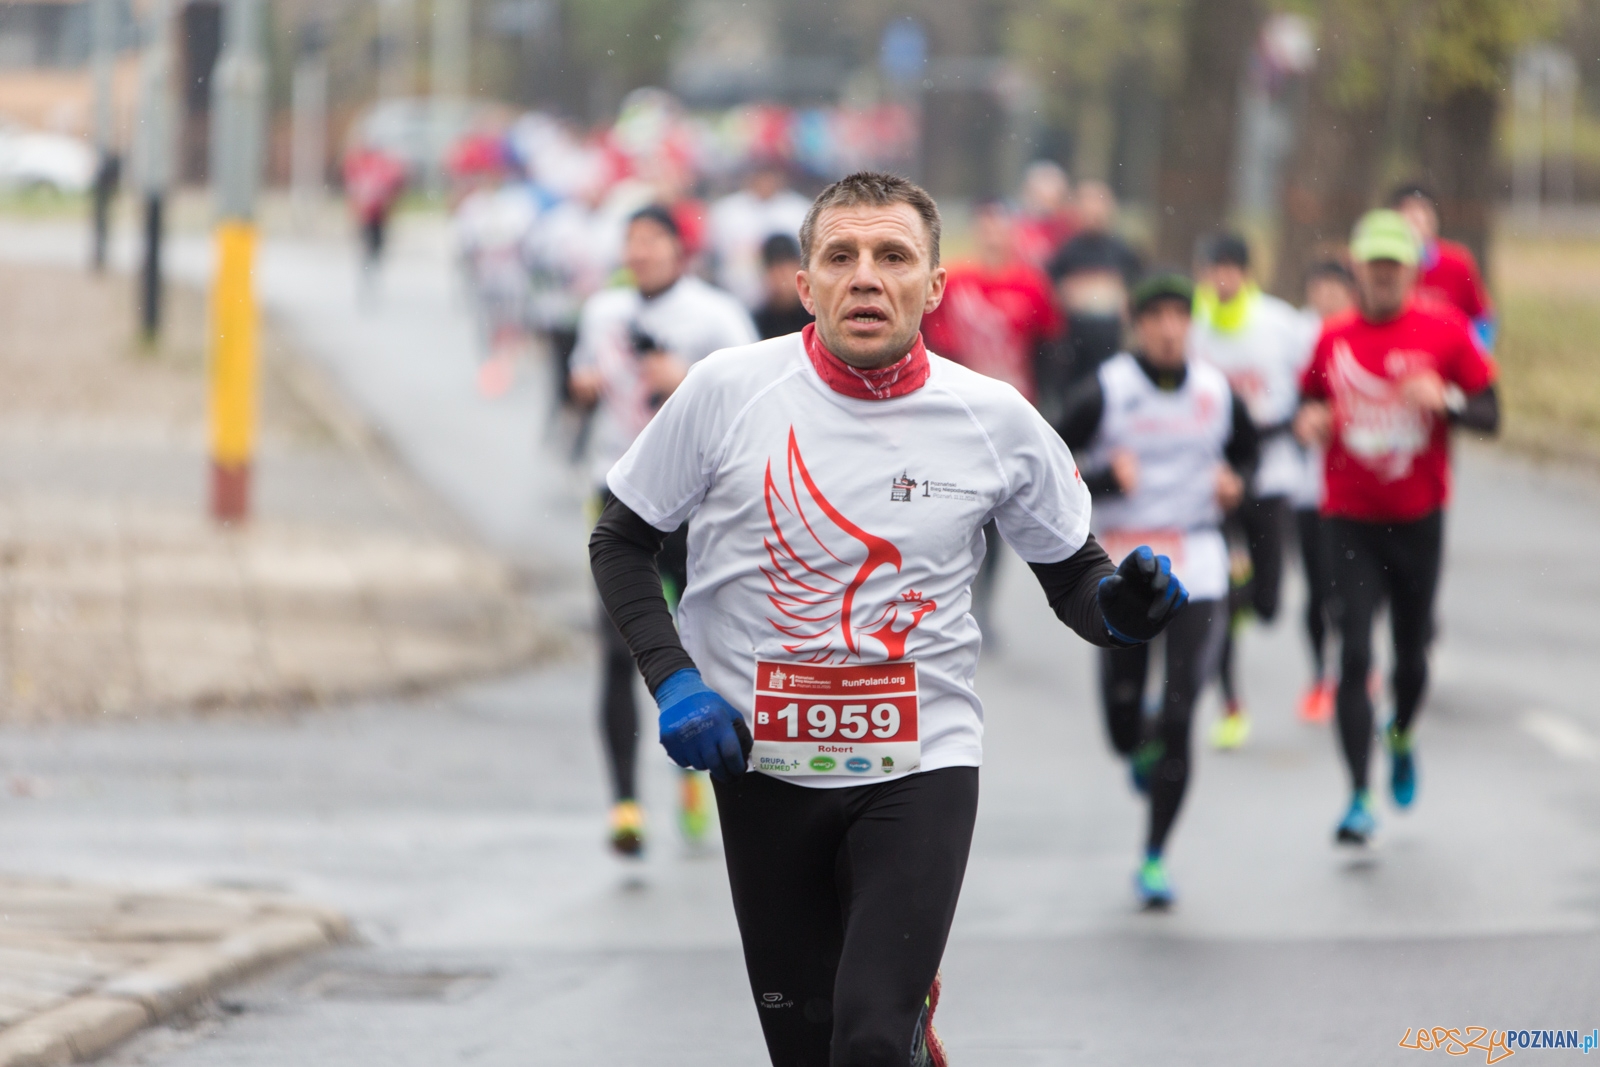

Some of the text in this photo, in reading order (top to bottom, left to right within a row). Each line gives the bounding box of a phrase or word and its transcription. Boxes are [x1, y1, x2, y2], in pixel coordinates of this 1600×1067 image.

[922, 480, 931, 497] 1
[789, 674, 797, 687] 1
[841, 676, 906, 688] RunPoland.org
[757, 702, 901, 740] B 1959
[818, 745, 853, 753] Robert
[760, 757, 786, 765] GRUPA
[760, 764, 791, 772] LUXMED
